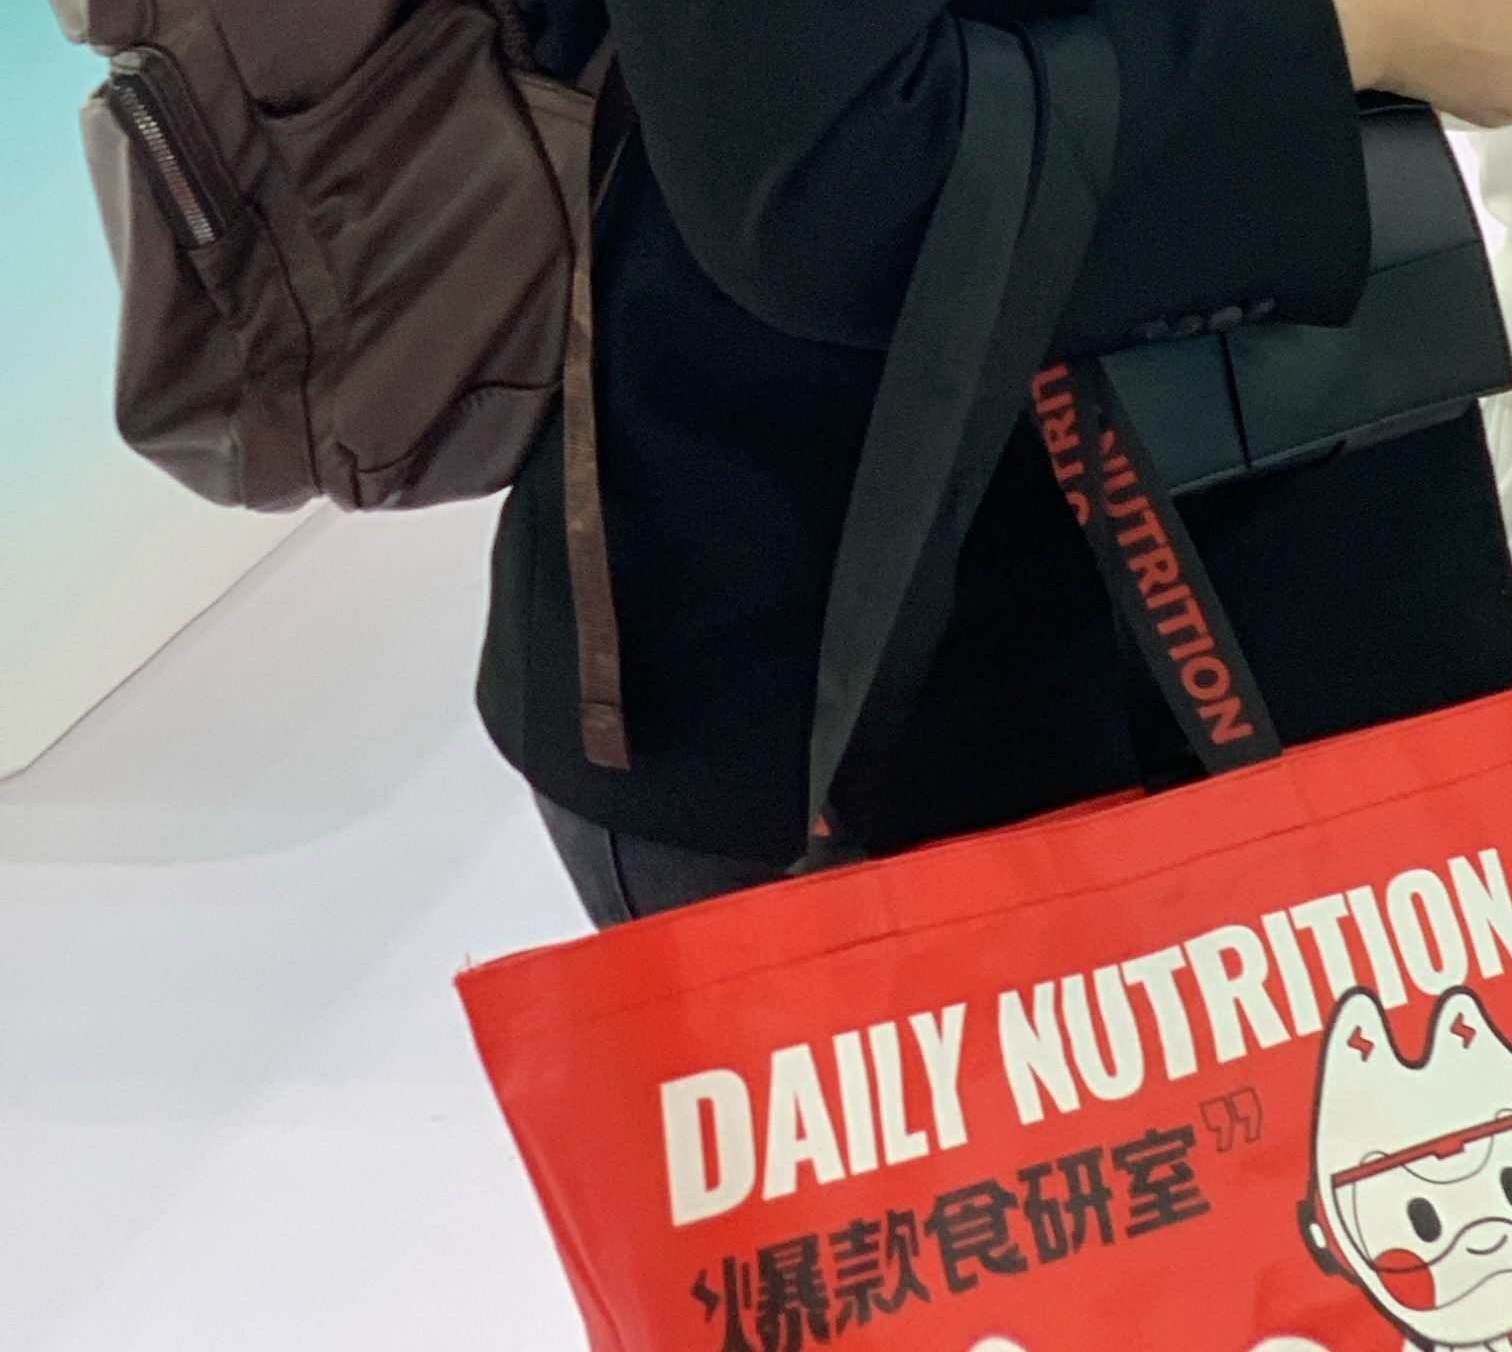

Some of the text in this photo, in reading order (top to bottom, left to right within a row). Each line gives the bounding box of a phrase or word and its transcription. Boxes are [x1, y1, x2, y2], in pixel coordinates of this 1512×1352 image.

[659, 1003, 978, 1227] DAILY
[690, 1123, 1212, 1352] 爆款食研室
